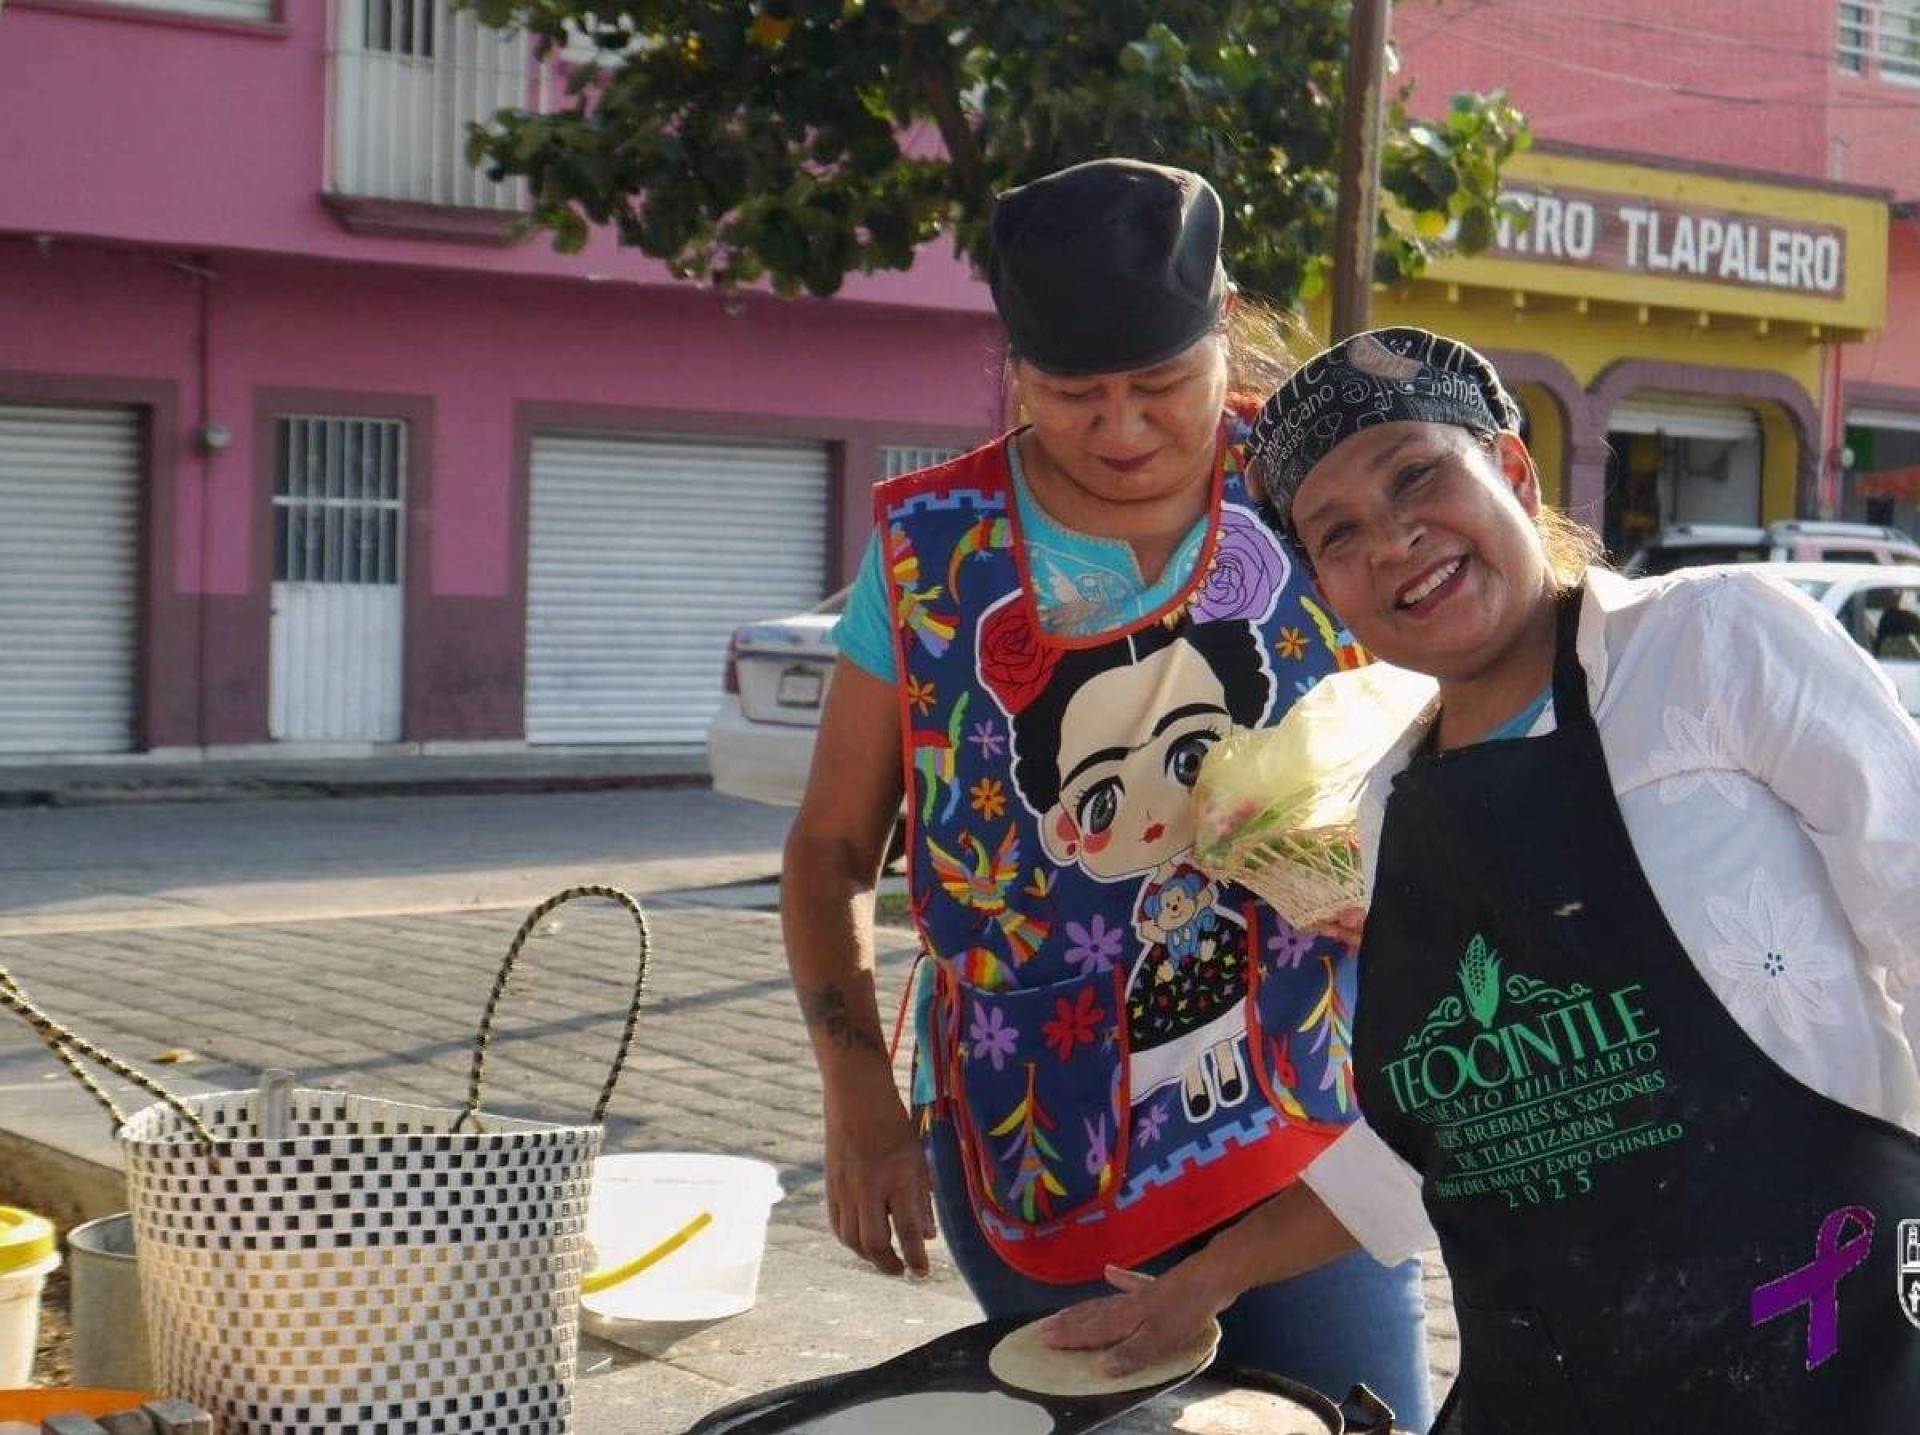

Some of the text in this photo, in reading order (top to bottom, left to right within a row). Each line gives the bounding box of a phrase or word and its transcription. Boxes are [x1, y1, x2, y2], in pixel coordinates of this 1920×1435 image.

[1619, 207, 1841, 290] TLAPALERO
[1381, 984, 1660, 1114] TEOCINTLE
[1464, 1103, 1551, 1145] BREBAJES
[1552, 1100, 1570, 1121] &
[1574, 1069, 1665, 1114] SAZONES
[1530, 1164, 1541, 1180] Y
[1546, 1150, 1593, 1176] EXPO
[1596, 1123, 1684, 1160] CHINELO
